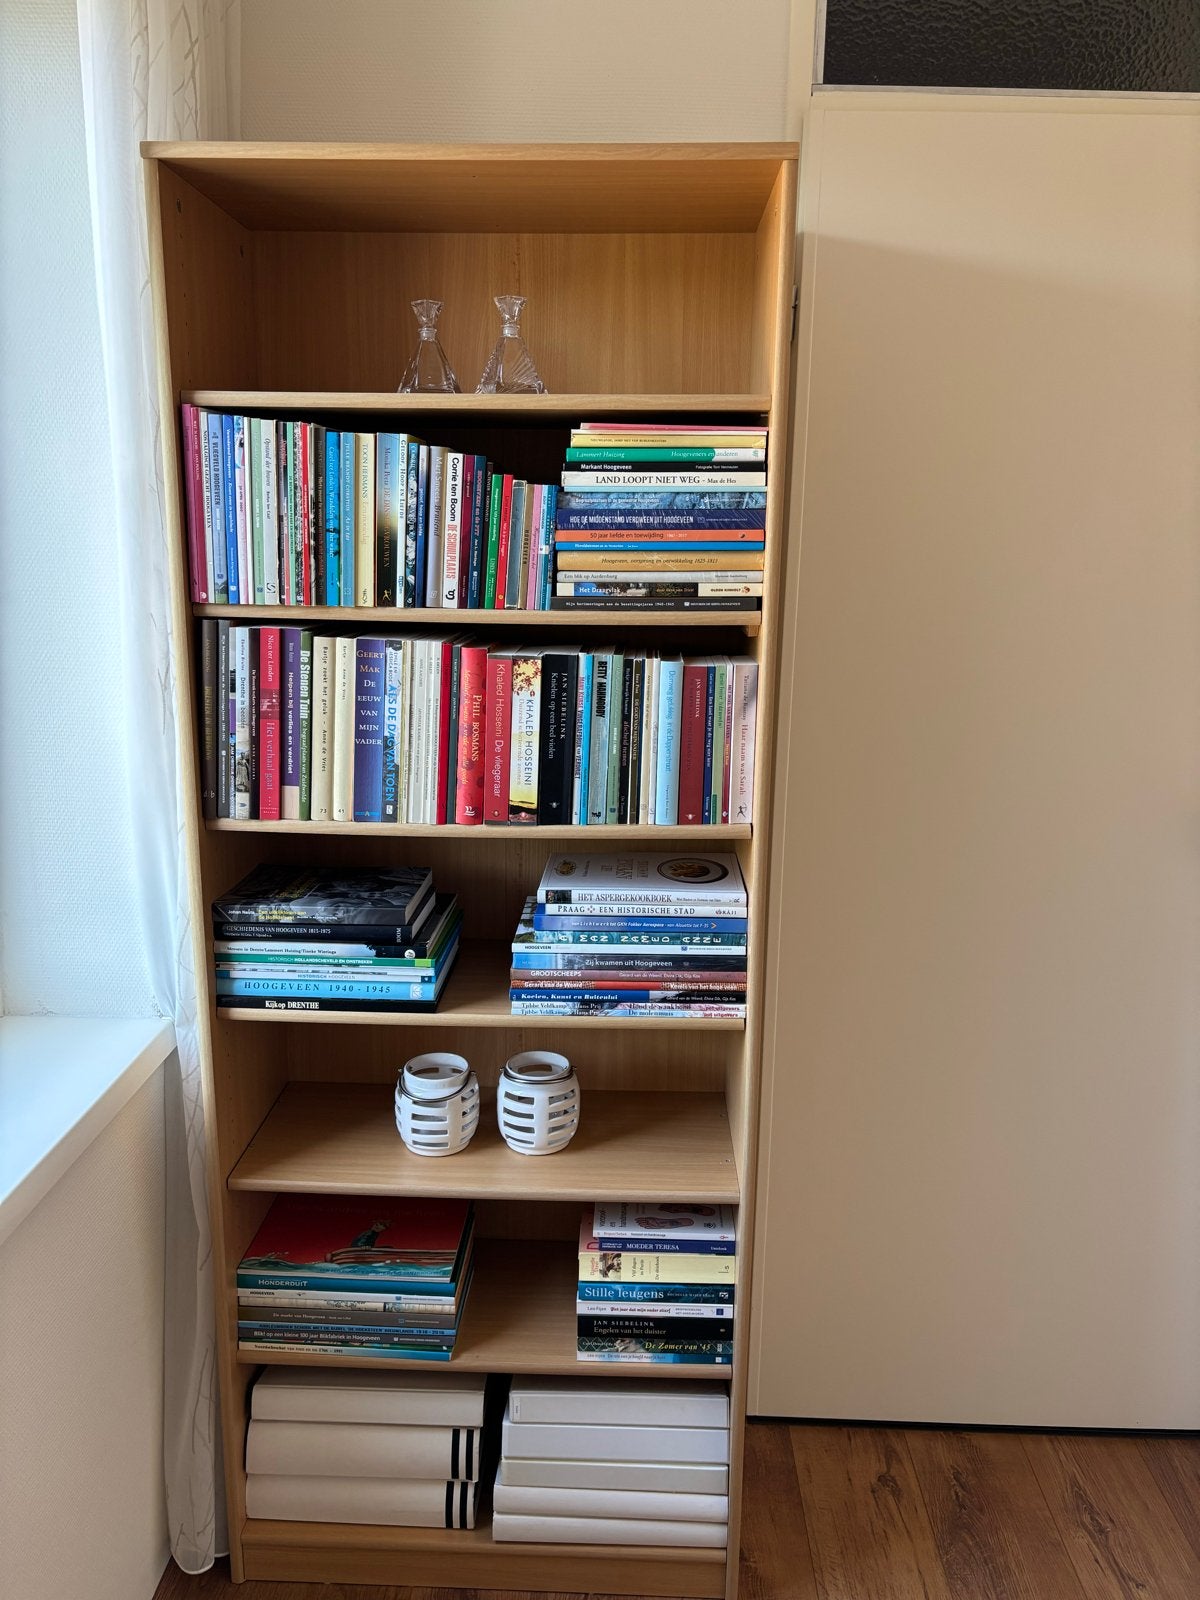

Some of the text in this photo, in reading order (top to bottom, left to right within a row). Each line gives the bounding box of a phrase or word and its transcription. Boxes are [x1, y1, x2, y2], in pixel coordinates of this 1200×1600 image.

[264, 438, 272, 459] Opstand
[451, 457, 460, 482] Corrie
[595, 476, 620, 484] LAND
[623, 476, 653, 484] LOOPT
[655, 476, 677, 484] NIET
[679, 476, 700, 484] WEG
[213, 473, 221, 506] HOOGEVEEN
[450, 498, 458, 522] Boom
[448, 524, 457, 532] DE
[300, 650, 311, 663] De
[321, 646, 329, 664] Bartje
[356, 650, 385, 659] GEERT
[359, 665, 380, 673] MAK
[300, 664, 310, 698] Stenen
[550, 672, 558, 698] Knielen
[596, 661, 607, 718] BETTY MAHMOODY
[299, 699, 310, 719] Tuin
[549, 701, 556, 710] op
[266, 722, 275, 737] Het
[471, 694, 482, 761] PHIL BOSMANS
[492, 664, 505, 797] Khaled Hosseini De vliegeraar
[549, 725, 557, 738] bed
[740, 724, 748, 741] Haar
[288, 736, 293, 746] en
[386, 684, 397, 801] ALS DE DAG VAN TOEN
[524, 699, 534, 786] KHALED HOSSEINI
[548, 739, 556, 759] violen
[266, 740, 275, 772] verhaal
[462, 747, 467, 755] en
[574, 755, 582, 779] VERDRIET
[264, 773, 274, 790] gaat
[739, 776, 747, 795] Sarah
[595, 894, 672, 902] ASPERGEKOOKBOEK
[617, 906, 671, 914] HISTORISCHE
[244, 981, 320, 991] HOOGEVEEN
[287, 1001, 320, 1009] DRENTHE
[585, 1287, 664, 1300] Stille leugens
[658, 1342, 682, 1350] Zomer
